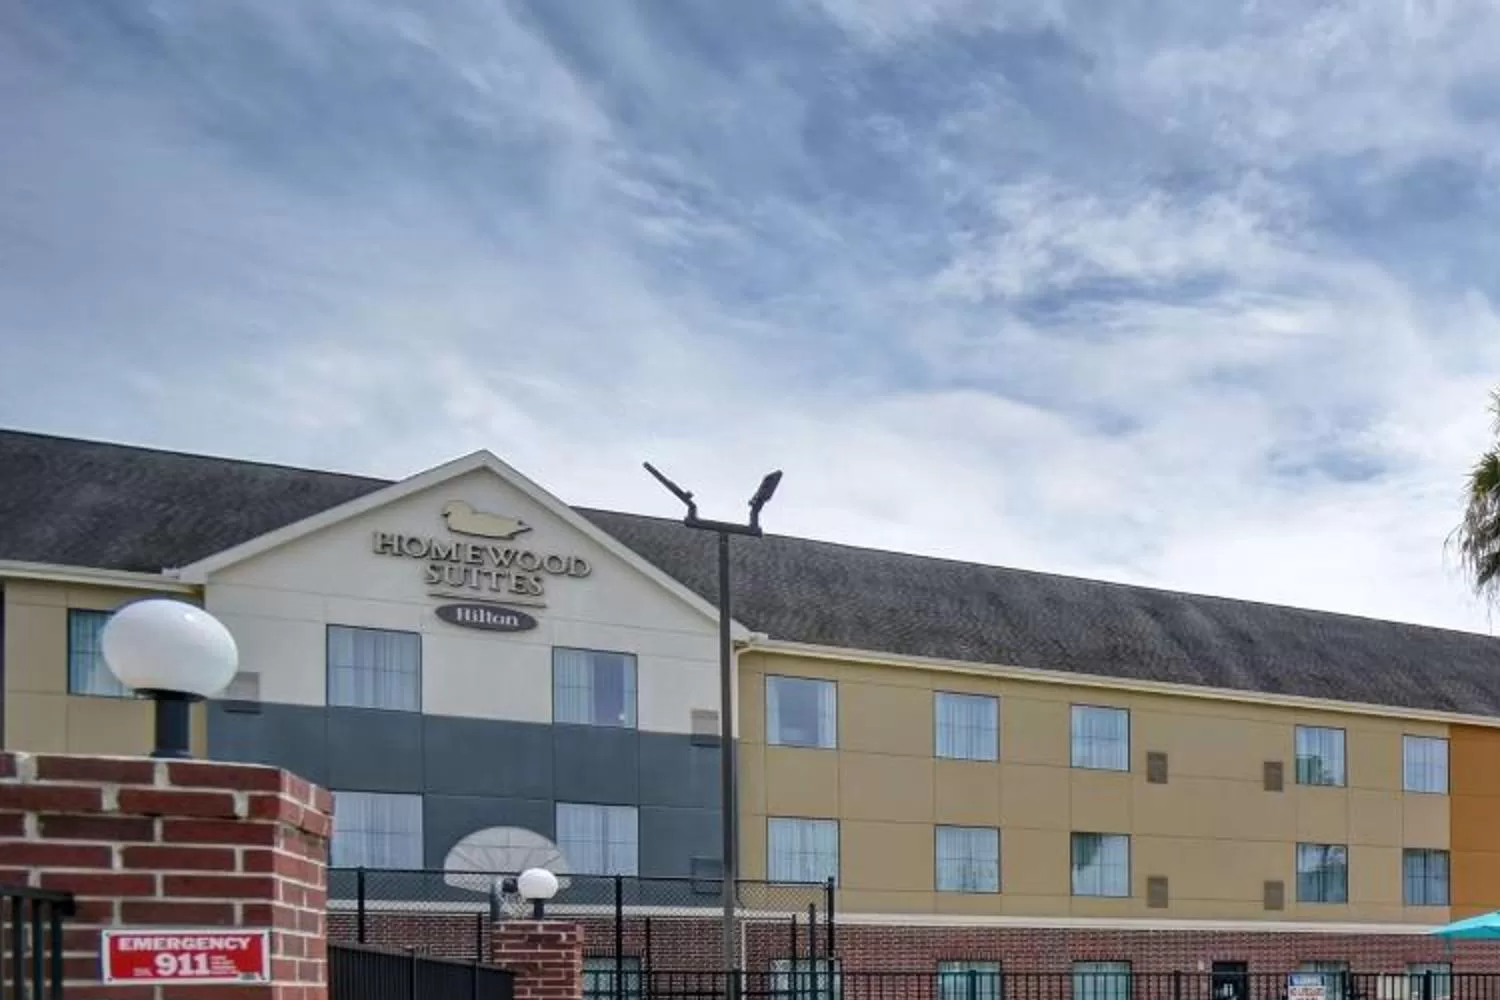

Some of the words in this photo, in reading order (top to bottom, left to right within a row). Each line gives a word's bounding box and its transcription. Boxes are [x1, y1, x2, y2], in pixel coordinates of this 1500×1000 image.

[372, 530, 592, 577] HOMEWOOD
[424, 562, 544, 596] SUITES
[457, 607, 520, 626] Hilton
[118, 936, 250, 951] EMERGENCY
[154, 952, 210, 976] 911
